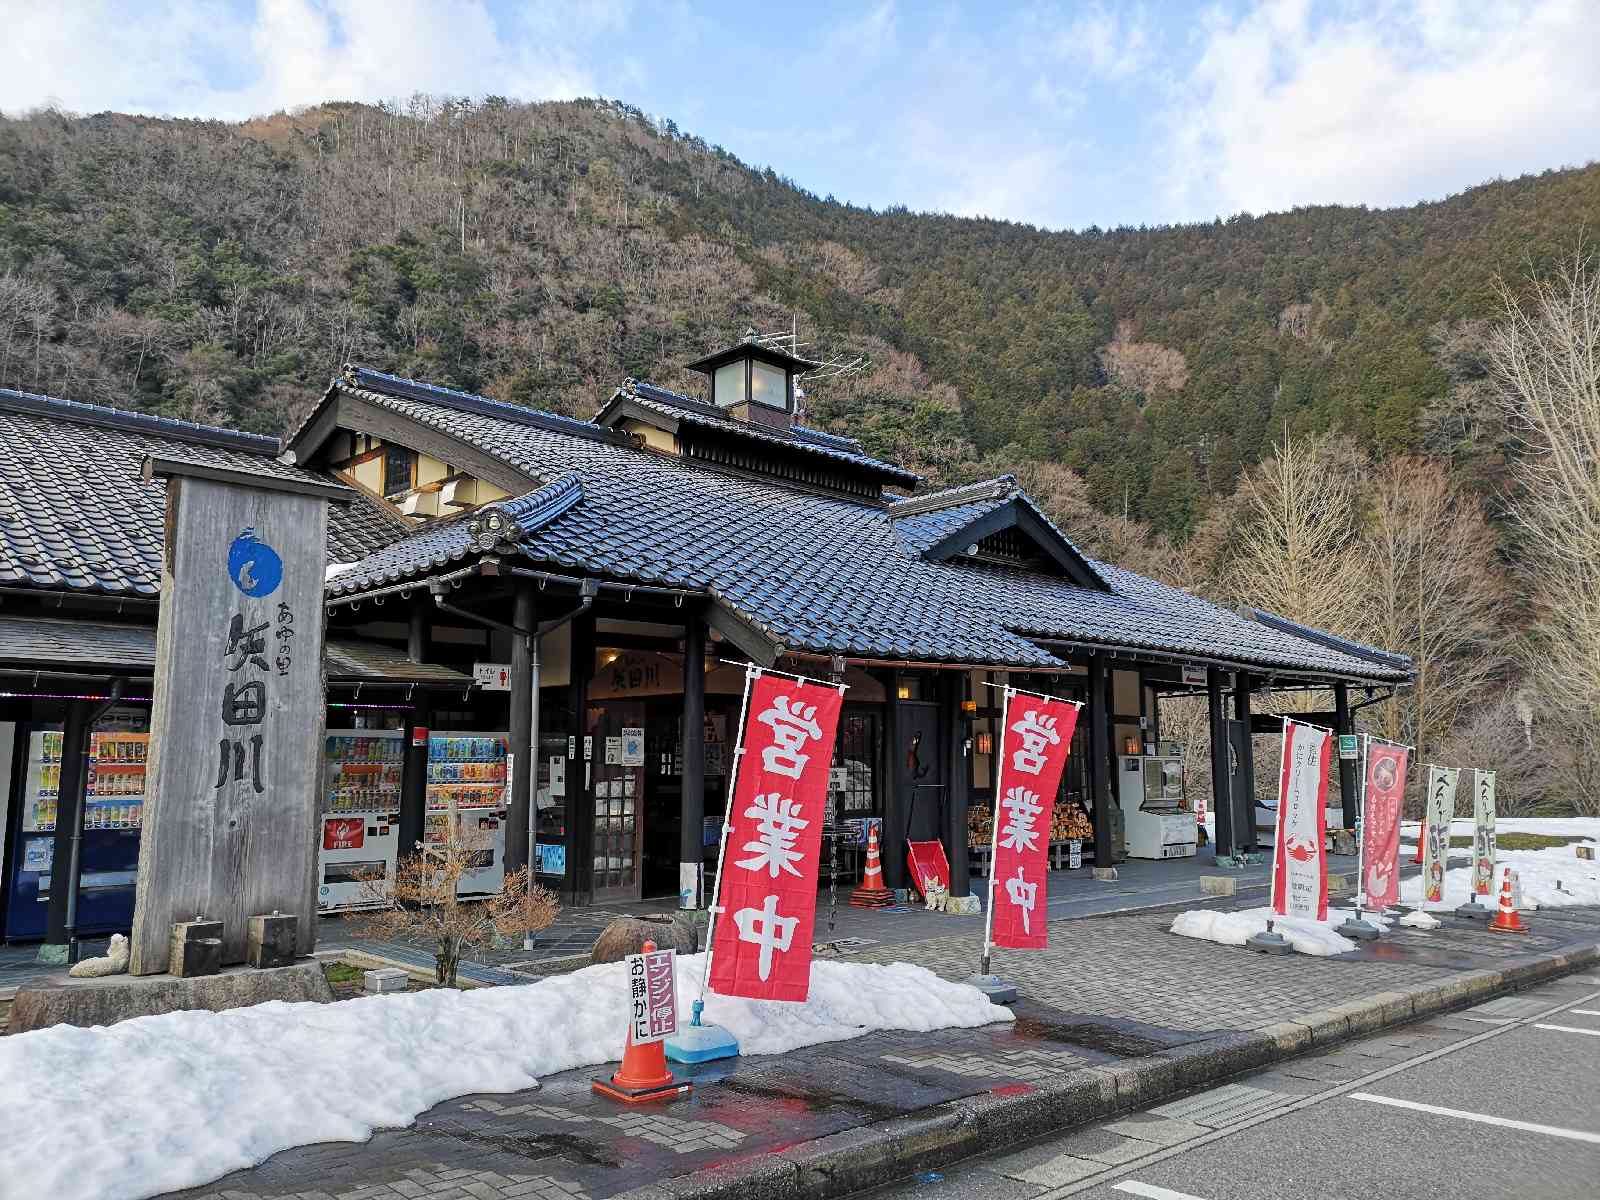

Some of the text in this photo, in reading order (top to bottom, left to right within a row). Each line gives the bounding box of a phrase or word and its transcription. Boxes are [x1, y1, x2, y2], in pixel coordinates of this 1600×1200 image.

[214, 613, 271, 794] 矢田川
[333, 840, 353, 848] FIRE
[734, 695, 823, 982] 営業中
[999, 710, 1061, 936] 営業中
[630, 956, 649, 1040] お静かに
[649, 952, 674, 1036] エンジン停止
